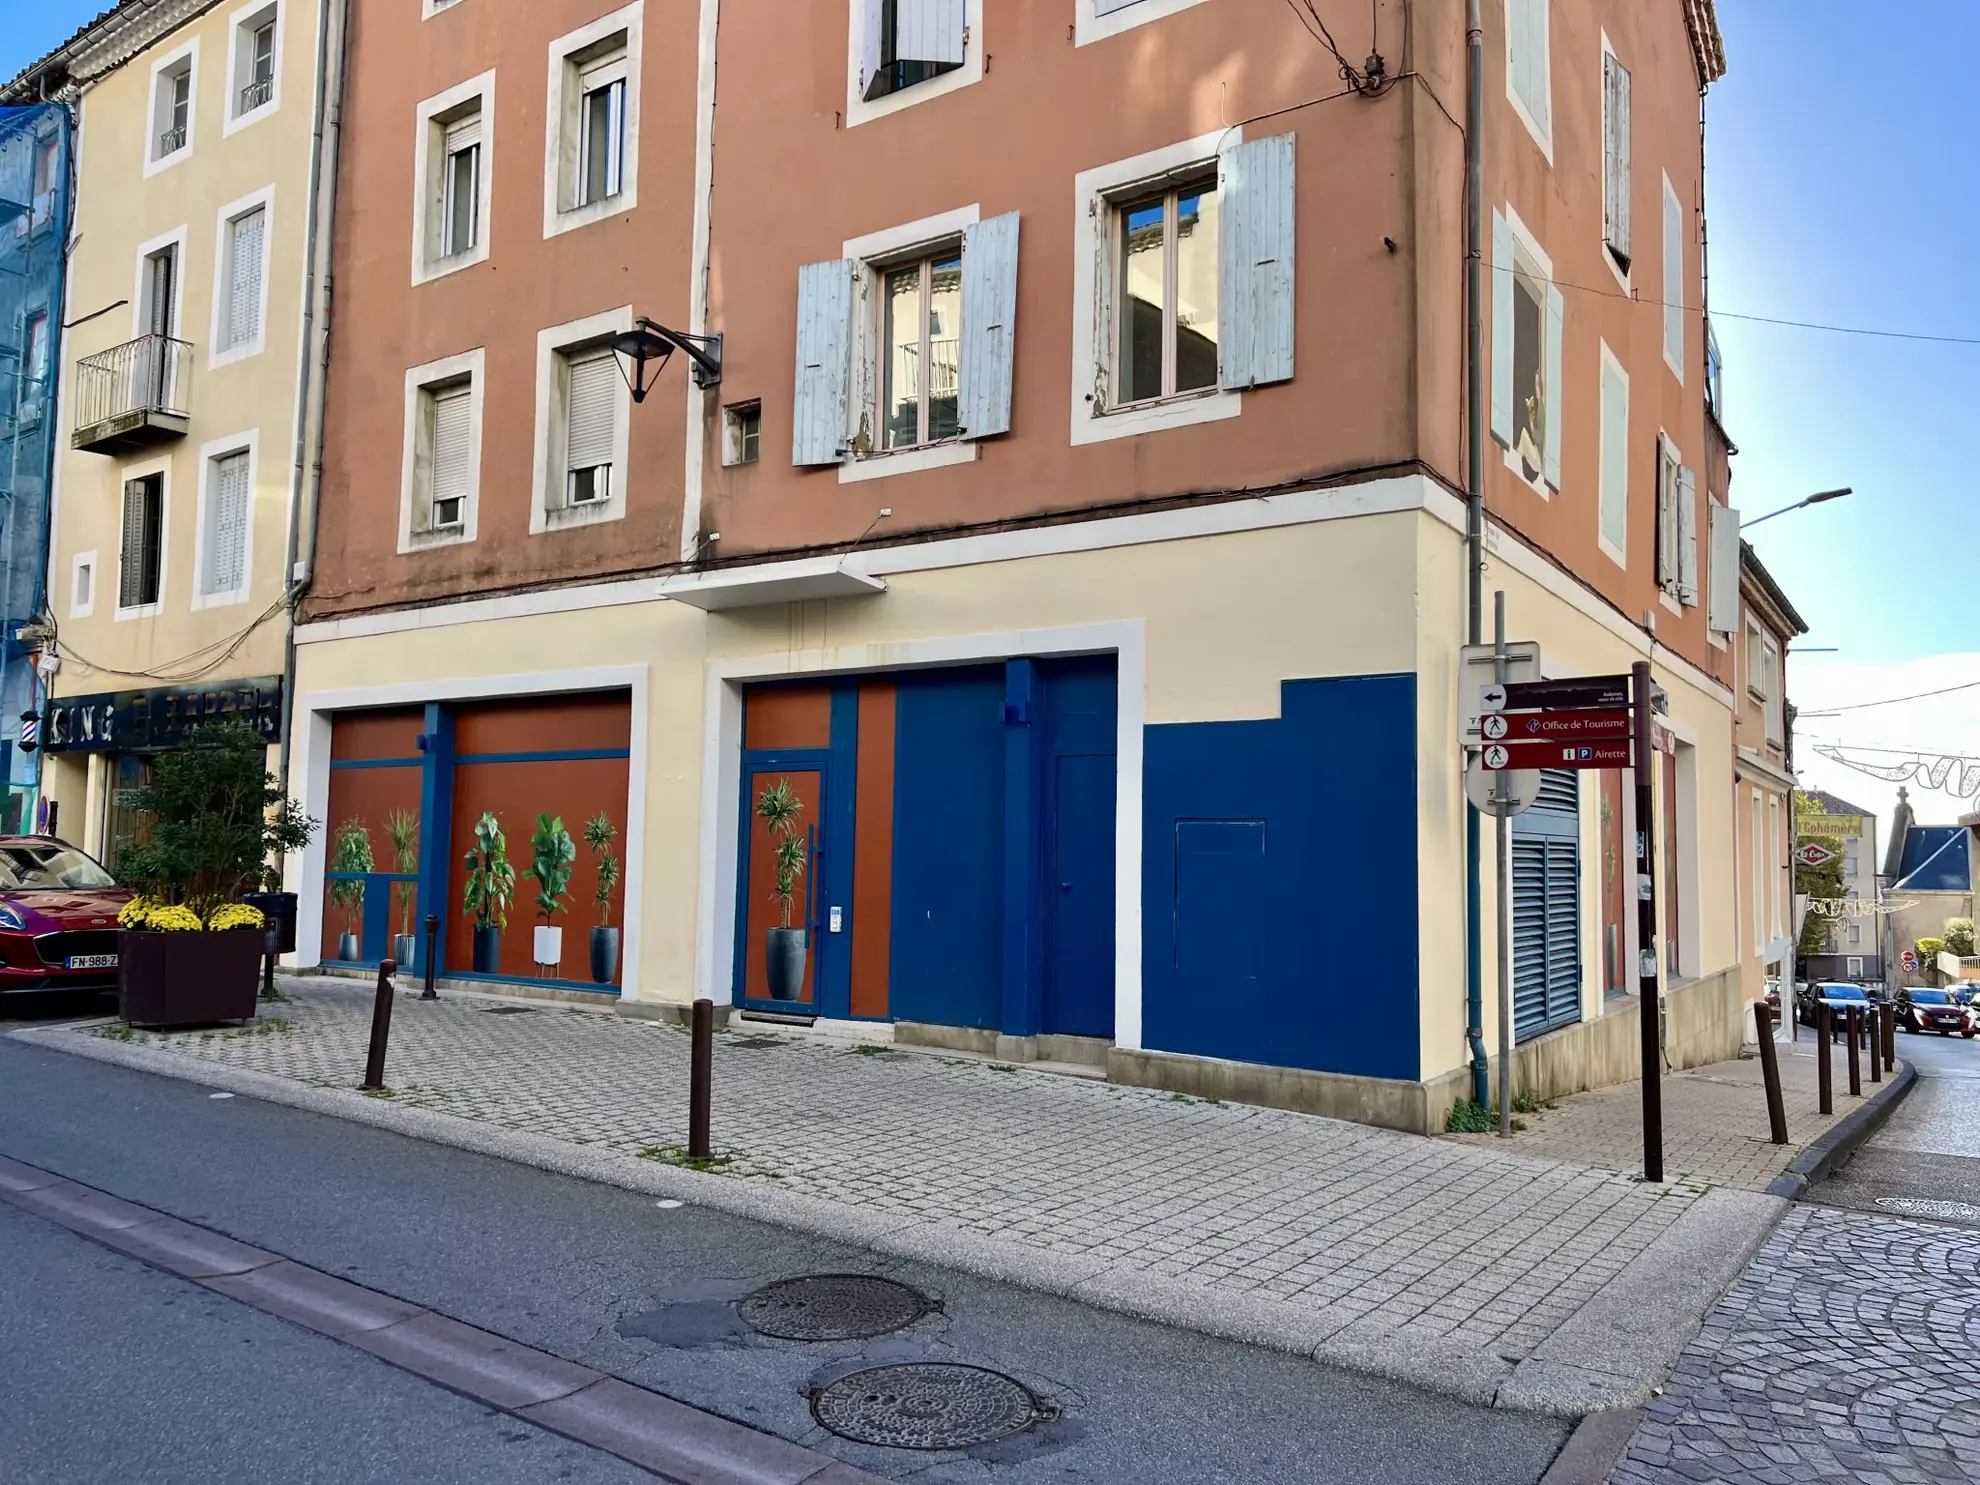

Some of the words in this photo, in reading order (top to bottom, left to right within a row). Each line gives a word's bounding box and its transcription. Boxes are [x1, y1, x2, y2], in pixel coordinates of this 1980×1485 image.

[50, 705, 115, 745] KING
[1542, 720, 1569, 730] Office
[1570, 719, 1582, 729] de
[1583, 718, 1625, 729] Tourisme
[1595, 749, 1626, 759] Airette
[71, 955, 119, 968] FN-988-Z
